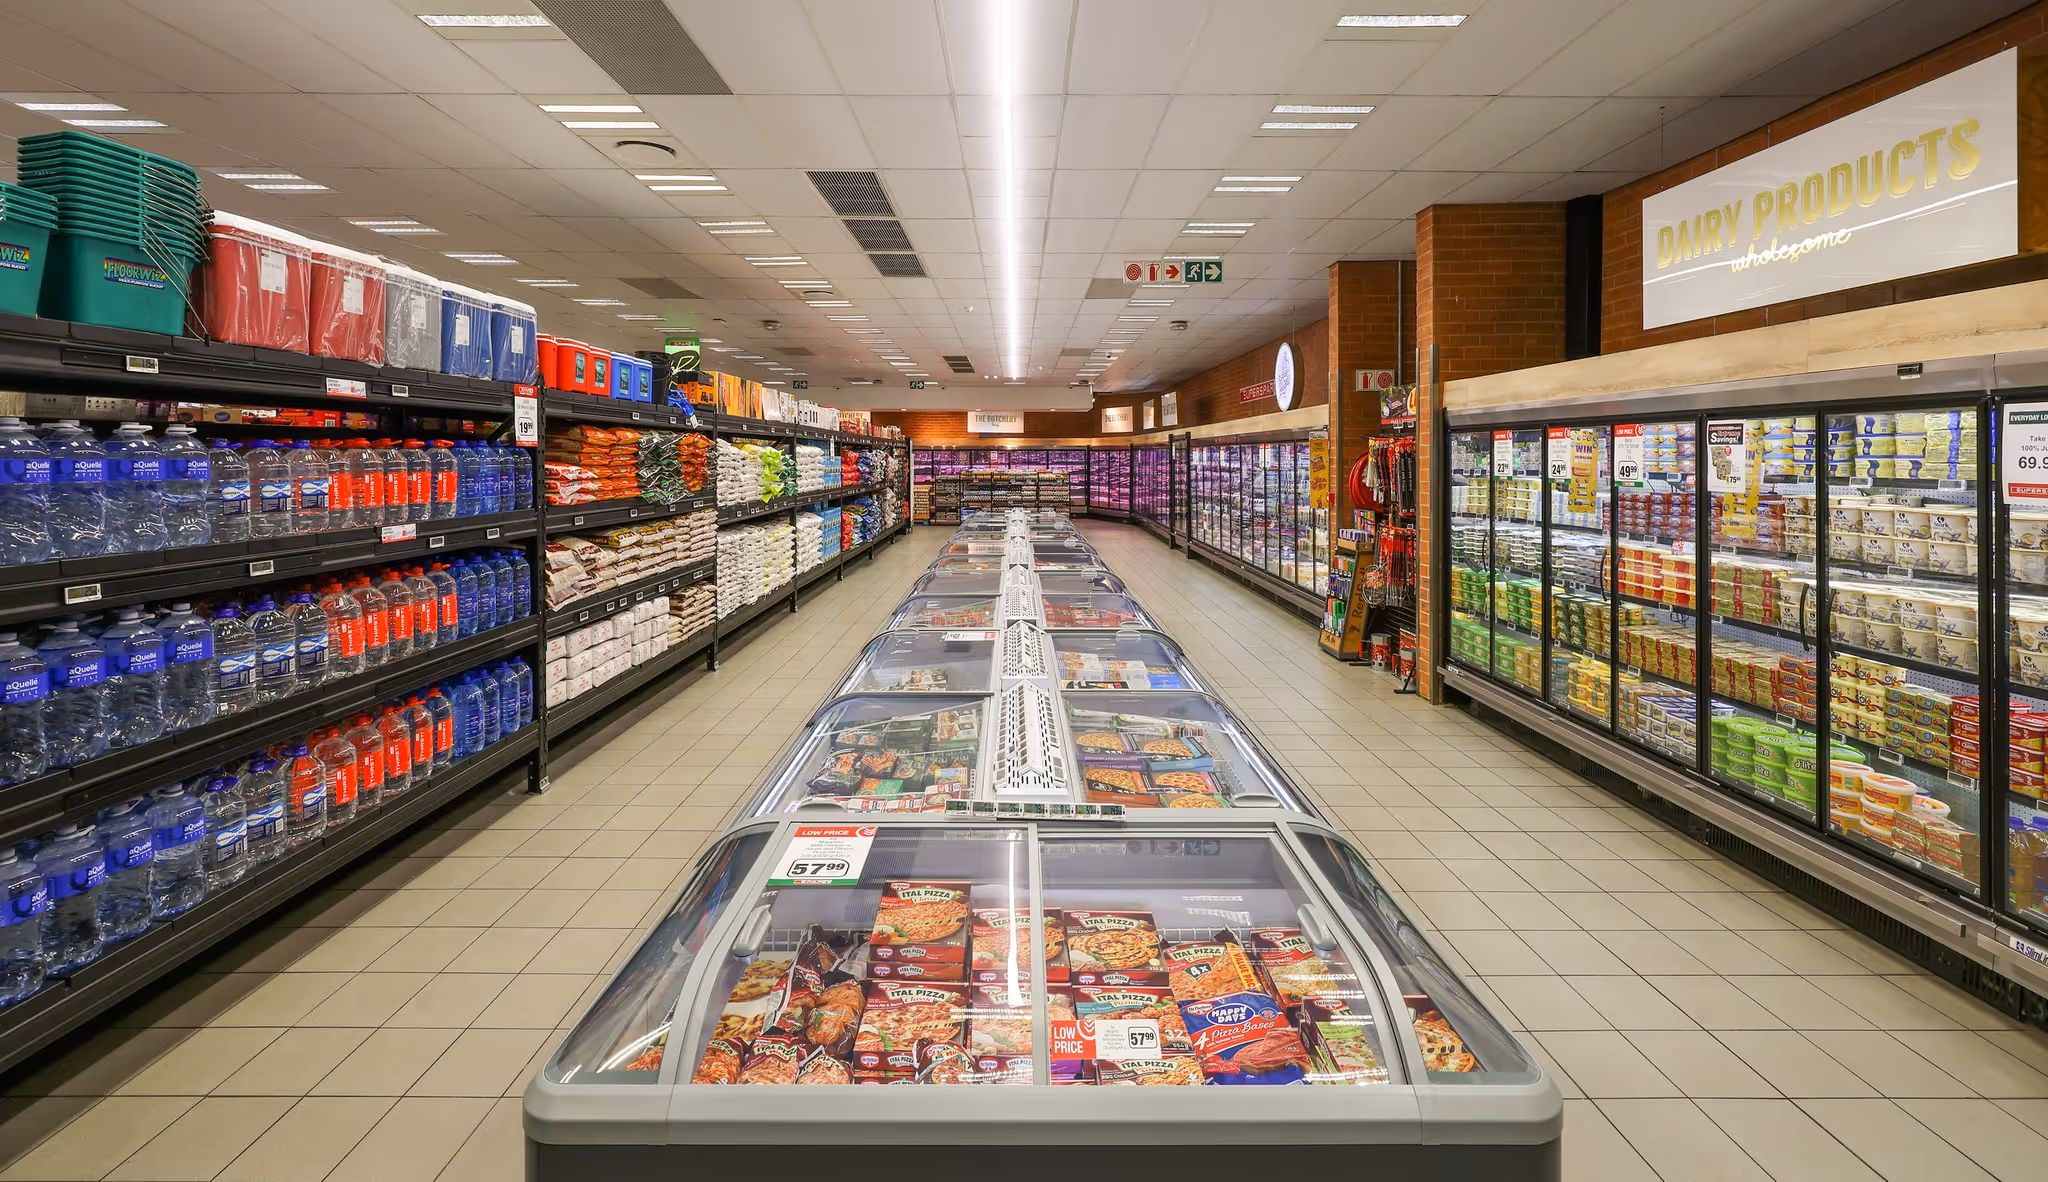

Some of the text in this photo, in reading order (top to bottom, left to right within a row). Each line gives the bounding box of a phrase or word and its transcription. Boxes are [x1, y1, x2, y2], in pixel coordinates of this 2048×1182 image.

[1657, 117, 1981, 268] DAIRY PRODUCTS
[1731, 227, 1852, 273] wholesome
[2010, 414, 2040, 422] EVERYDAY
[1710, 433, 1739, 444] Savings!
[1576, 445, 1593, 453] WIN
[75, 461, 102, 469] aQuellé
[133, 460, 159, 469] aQuellé
[176, 641, 203, 652] aQuellé
[130, 652, 157, 663] aQuellé
[68, 662, 98, 676] aQuellé
[5, 677, 38, 691] aQuellé
[1795, 759, 1817, 771] d'lite
[791, 863, 846, 875] 5799
[924, 890, 951, 899] PIZZA
[1280, 937, 1305, 948] ITAL
[1173, 947, 1222, 959] ITAL PIZZA
[1233, 952, 1248, 974] VALUE
[1190, 965, 1208, 977] 4x
[891, 989, 946, 1000] ITAL PIZZA
[1096, 994, 1154, 1002] ITAL PIZZA
[1212, 1007, 1247, 1018] HAPPY
[1218, 1014, 1246, 1025] DAYS
[1054, 1027, 1074, 1040] LOW
[1130, 1032, 1154, 1046] 5799
[1165, 1029, 1184, 1038] 32
[1194, 1020, 1275, 1051] 4 Pizza Bases
[1054, 1041, 1083, 1054] PRICE
[1121, 1061, 1145, 1069] ITAL
